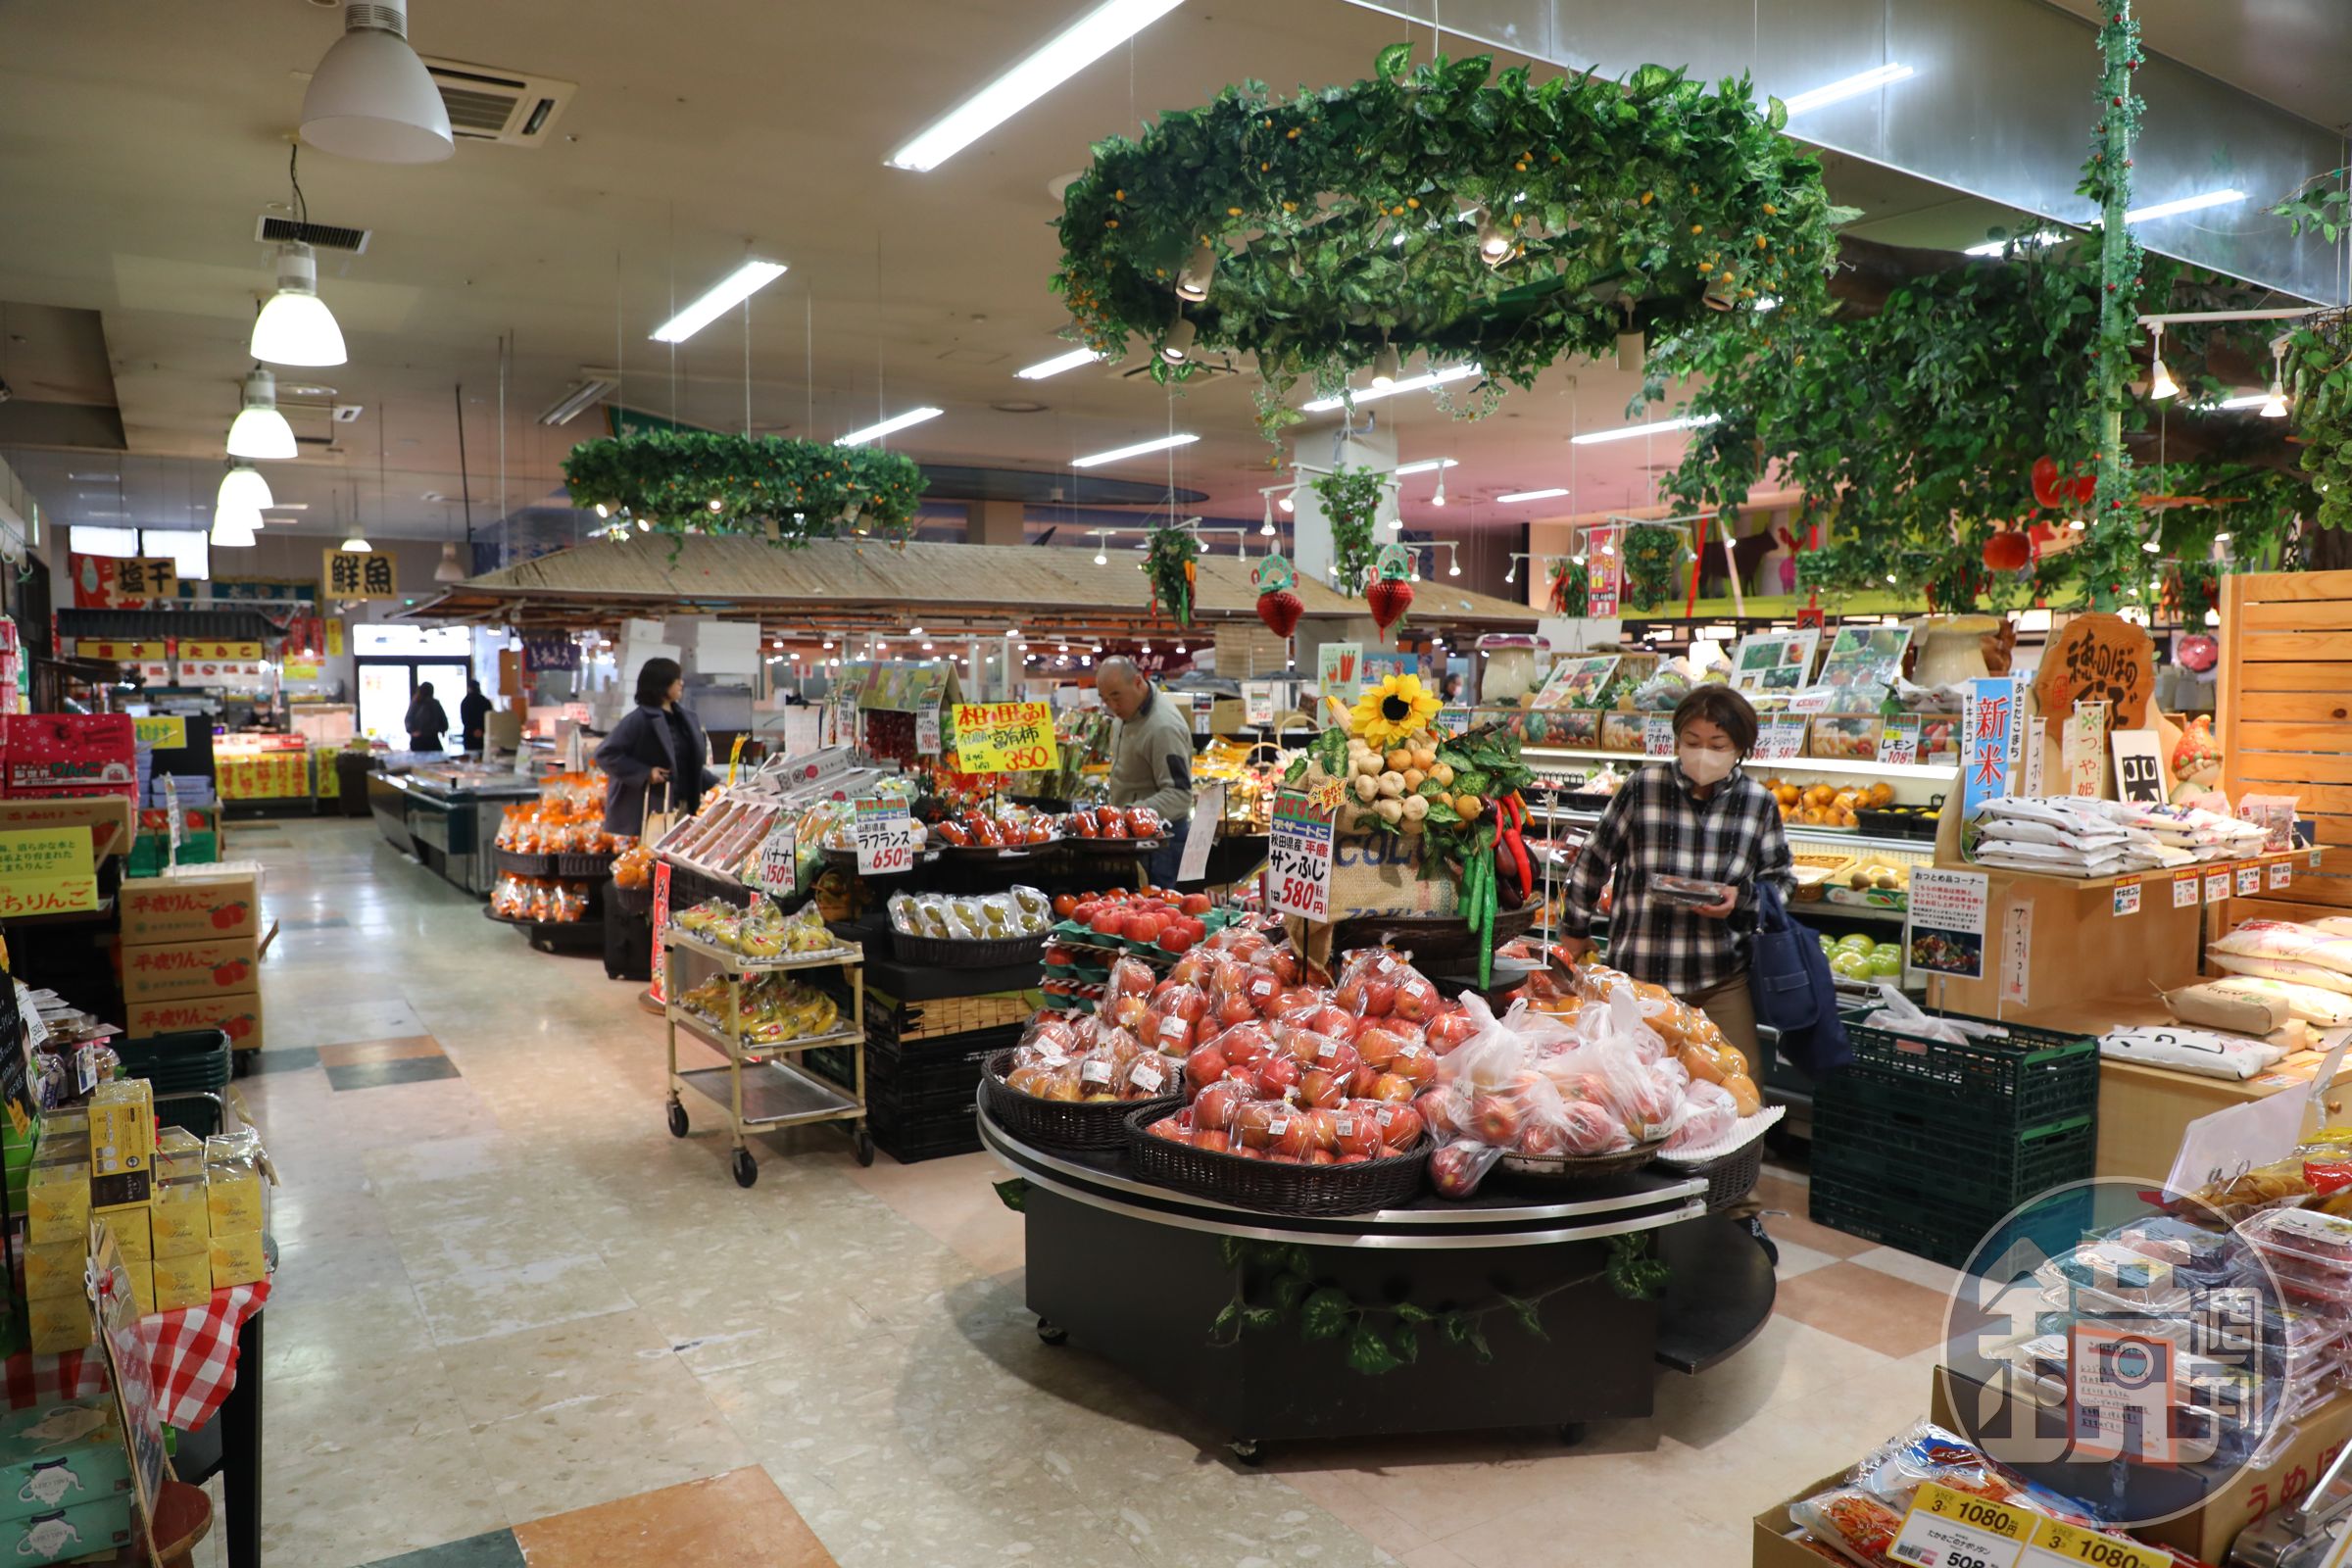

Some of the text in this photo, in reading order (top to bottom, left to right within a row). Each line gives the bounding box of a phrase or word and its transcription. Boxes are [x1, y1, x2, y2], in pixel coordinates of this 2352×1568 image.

[119, 562, 173, 594] 塩干
[332, 554, 392, 595] 鮮魚
[1965, 694, 1974, 755] サキホコレ
[2011, 683, 2024, 758] あきたこまち
[1653, 744, 1669, 755] 180
[1882, 739, 1914, 751] レモン
[1975, 697, 2008, 785] 新米
[1004, 746, 1049, 771] 350
[1887, 751, 1908, 763] 108
[2078, 737, 2098, 796] つや姫
[858, 823, 887, 833] 山形県産
[1273, 819, 1330, 839] デザートに
[858, 831, 910, 849] ラフランス
[1271, 834, 1329, 858] 秋田県産 平鹿
[761, 847, 792, 864] バナナ
[873, 847, 903, 869] 650
[1270, 850, 1326, 882] サンふじ
[766, 863, 785, 884] 150
[1915, 872, 1984, 885] おつとめ品コーナー
[0, 889, 89, 912] ちりんご
[130, 892, 217, 913] 平鹿りんご
[1282, 877, 1314, 910] 580
[133, 949, 220, 971] 平鹿りんご
[138, 1004, 224, 1027] 平鹿りんご
